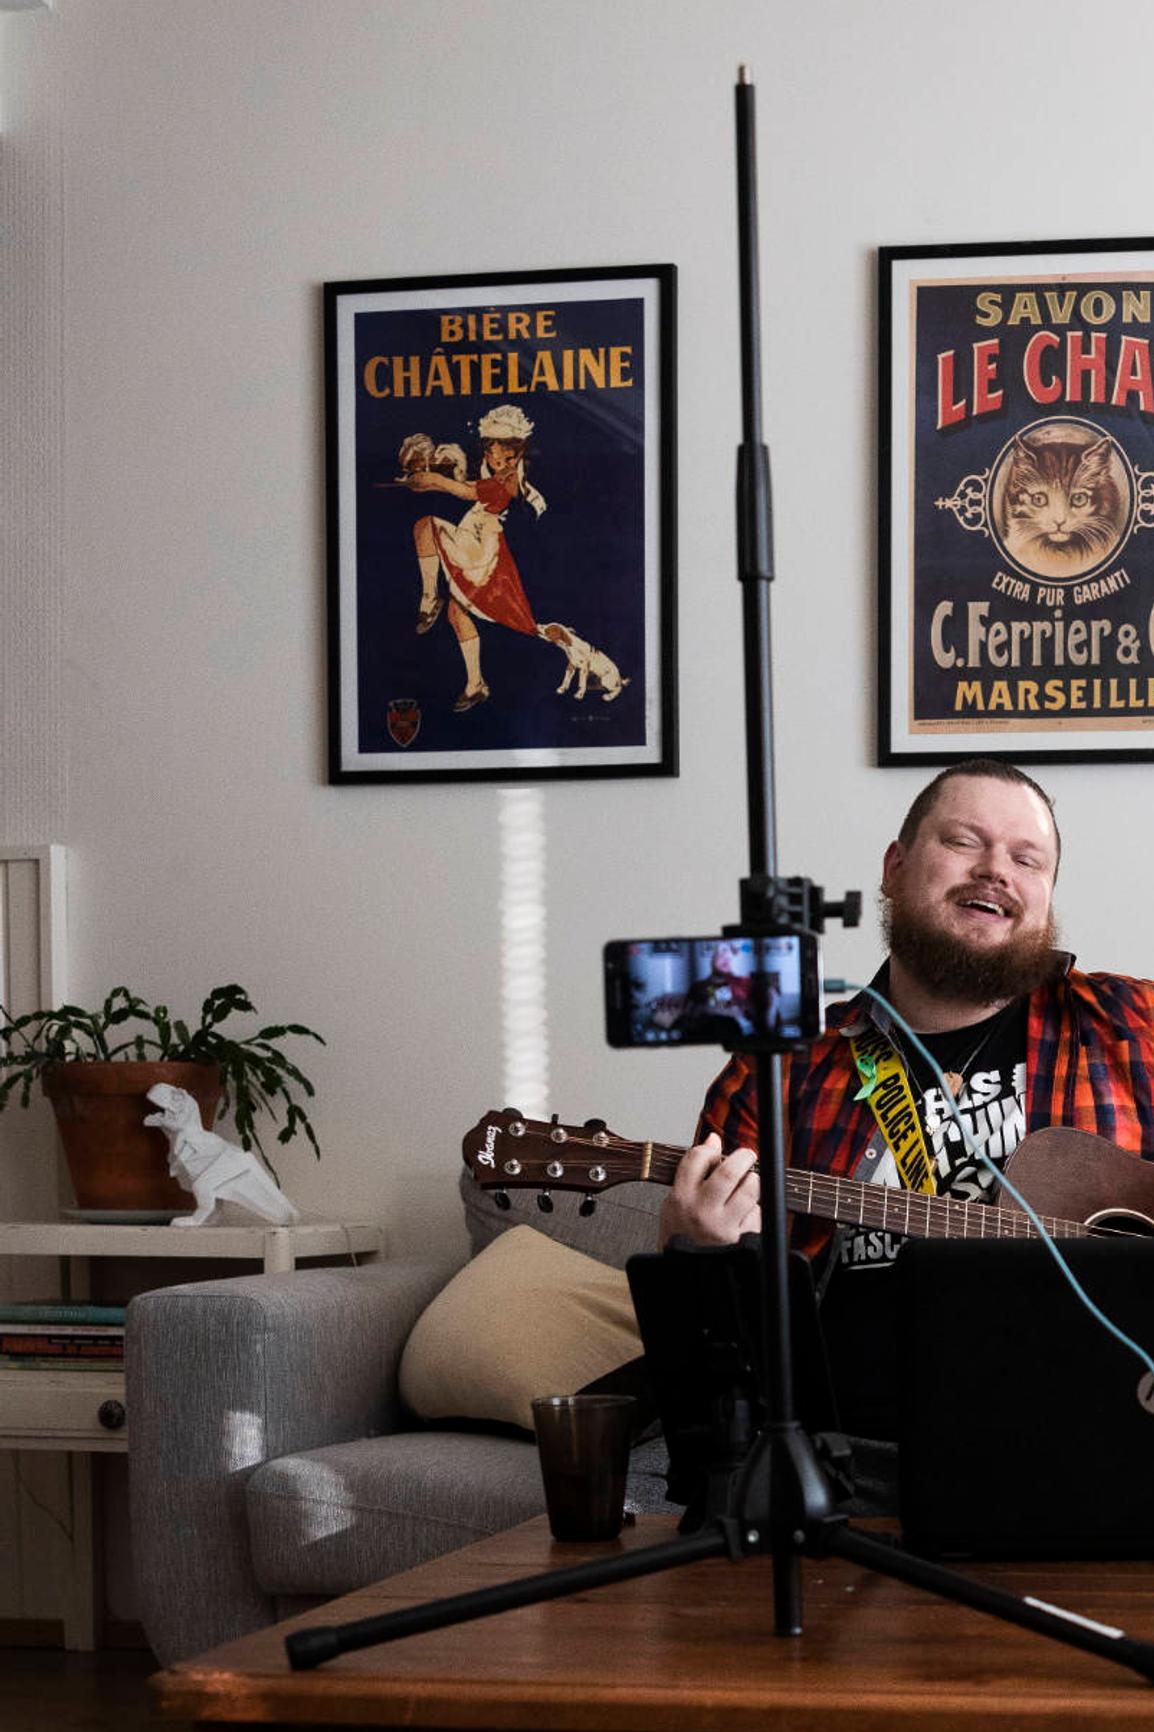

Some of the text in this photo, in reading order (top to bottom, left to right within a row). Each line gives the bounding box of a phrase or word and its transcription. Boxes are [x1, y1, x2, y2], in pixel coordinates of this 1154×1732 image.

[440, 307, 558, 342] BIÈRE
[975, 290, 1151, 327] SAVON
[363, 346, 634, 398] CHÂTELAINE
[937, 337, 1004, 431] LE
[991, 568, 1131, 607] EXTRA PUR GARANTI
[1116, 623, 1141, 665] &
[477, 1125, 502, 1168] Ibanez
[872, 1072, 917, 1152] POLICE
[900, 1137, 929, 1192] LINE
